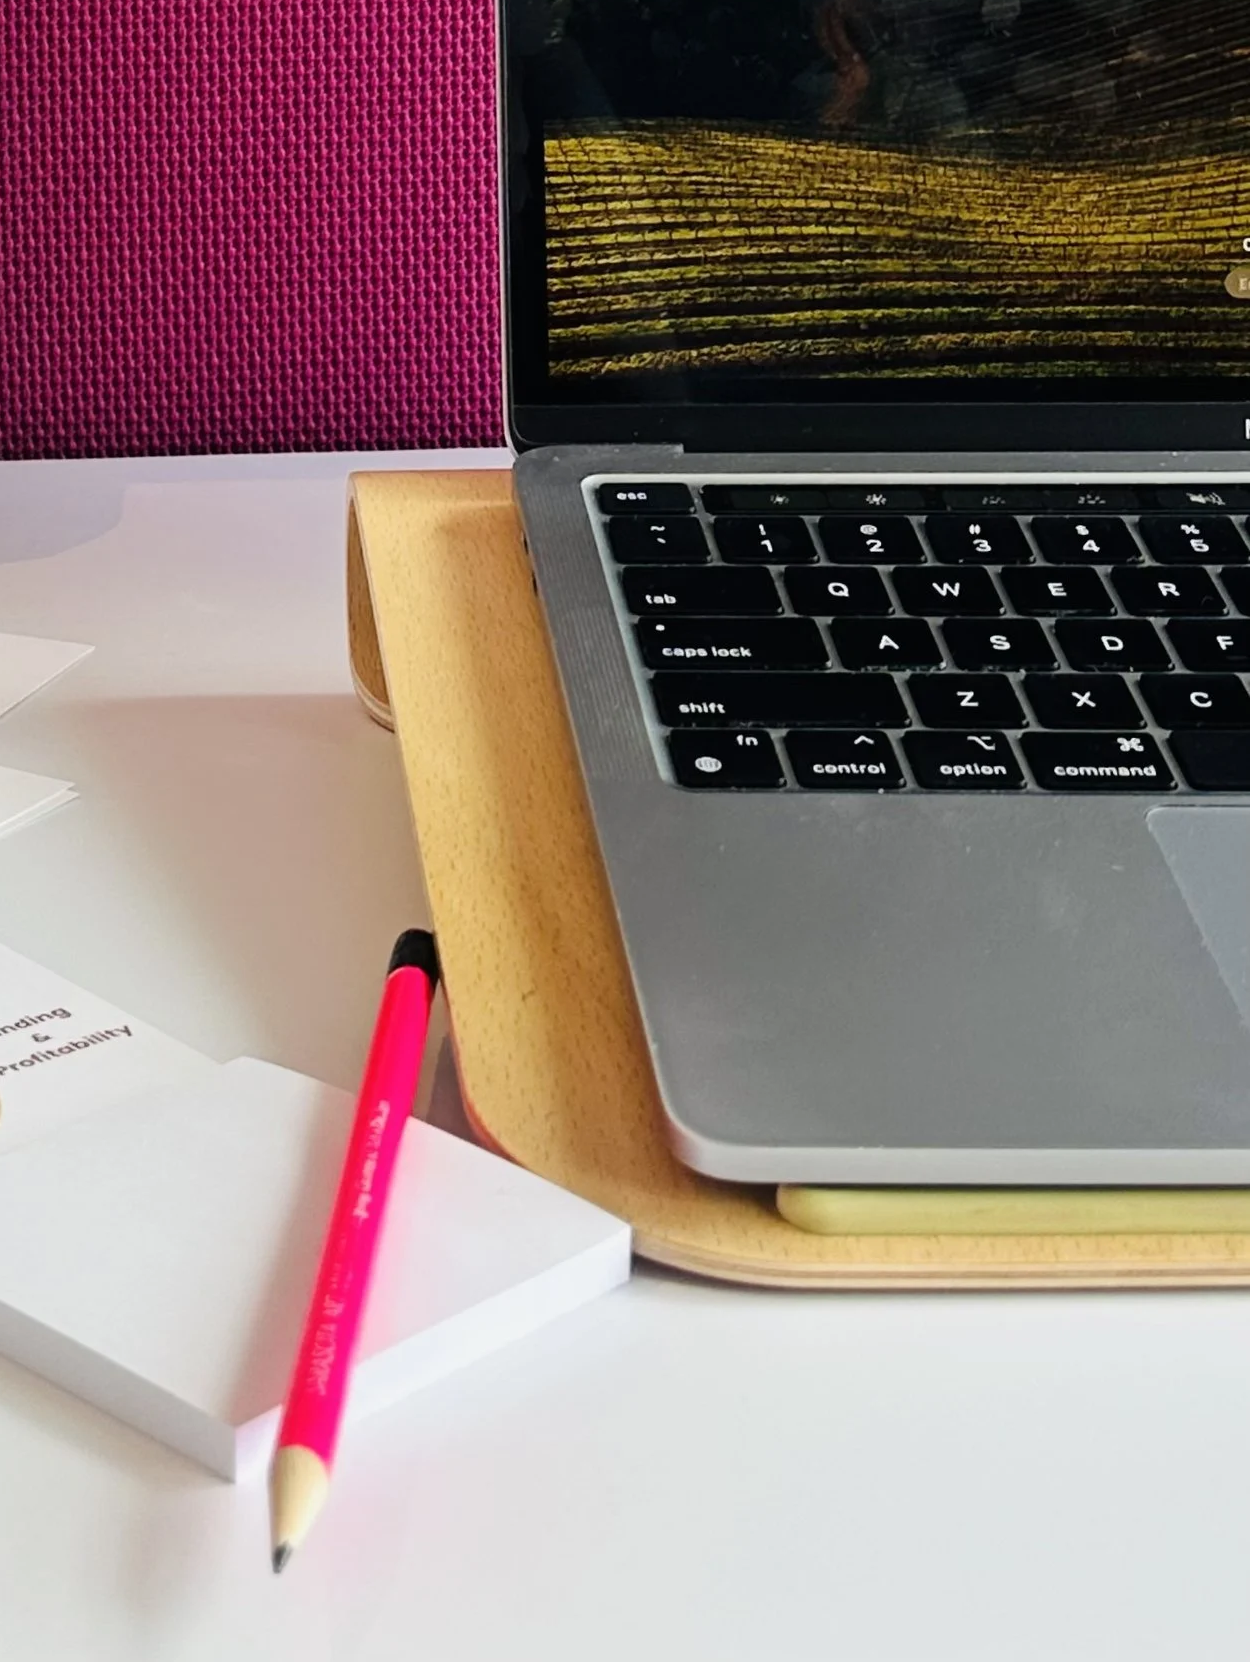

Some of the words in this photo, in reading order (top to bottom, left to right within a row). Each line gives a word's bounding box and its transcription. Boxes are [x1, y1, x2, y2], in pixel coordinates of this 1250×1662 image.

[615, 490, 649, 502] esc
[645, 592, 677, 605] tab
[932, 582, 961, 597] W
[1047, 582, 1068, 597] E
[1158, 582, 1181, 598] R
[661, 645, 708, 661] caps
[711, 644, 753, 658] lock
[877, 635, 899, 651] A
[989, 634, 1012, 651] S
[678, 700, 726, 715] shift
[736, 734, 759, 747] fn
[812, 761, 887, 775] control
[939, 761, 1008, 779] option
[1053, 762, 1157, 778] command
